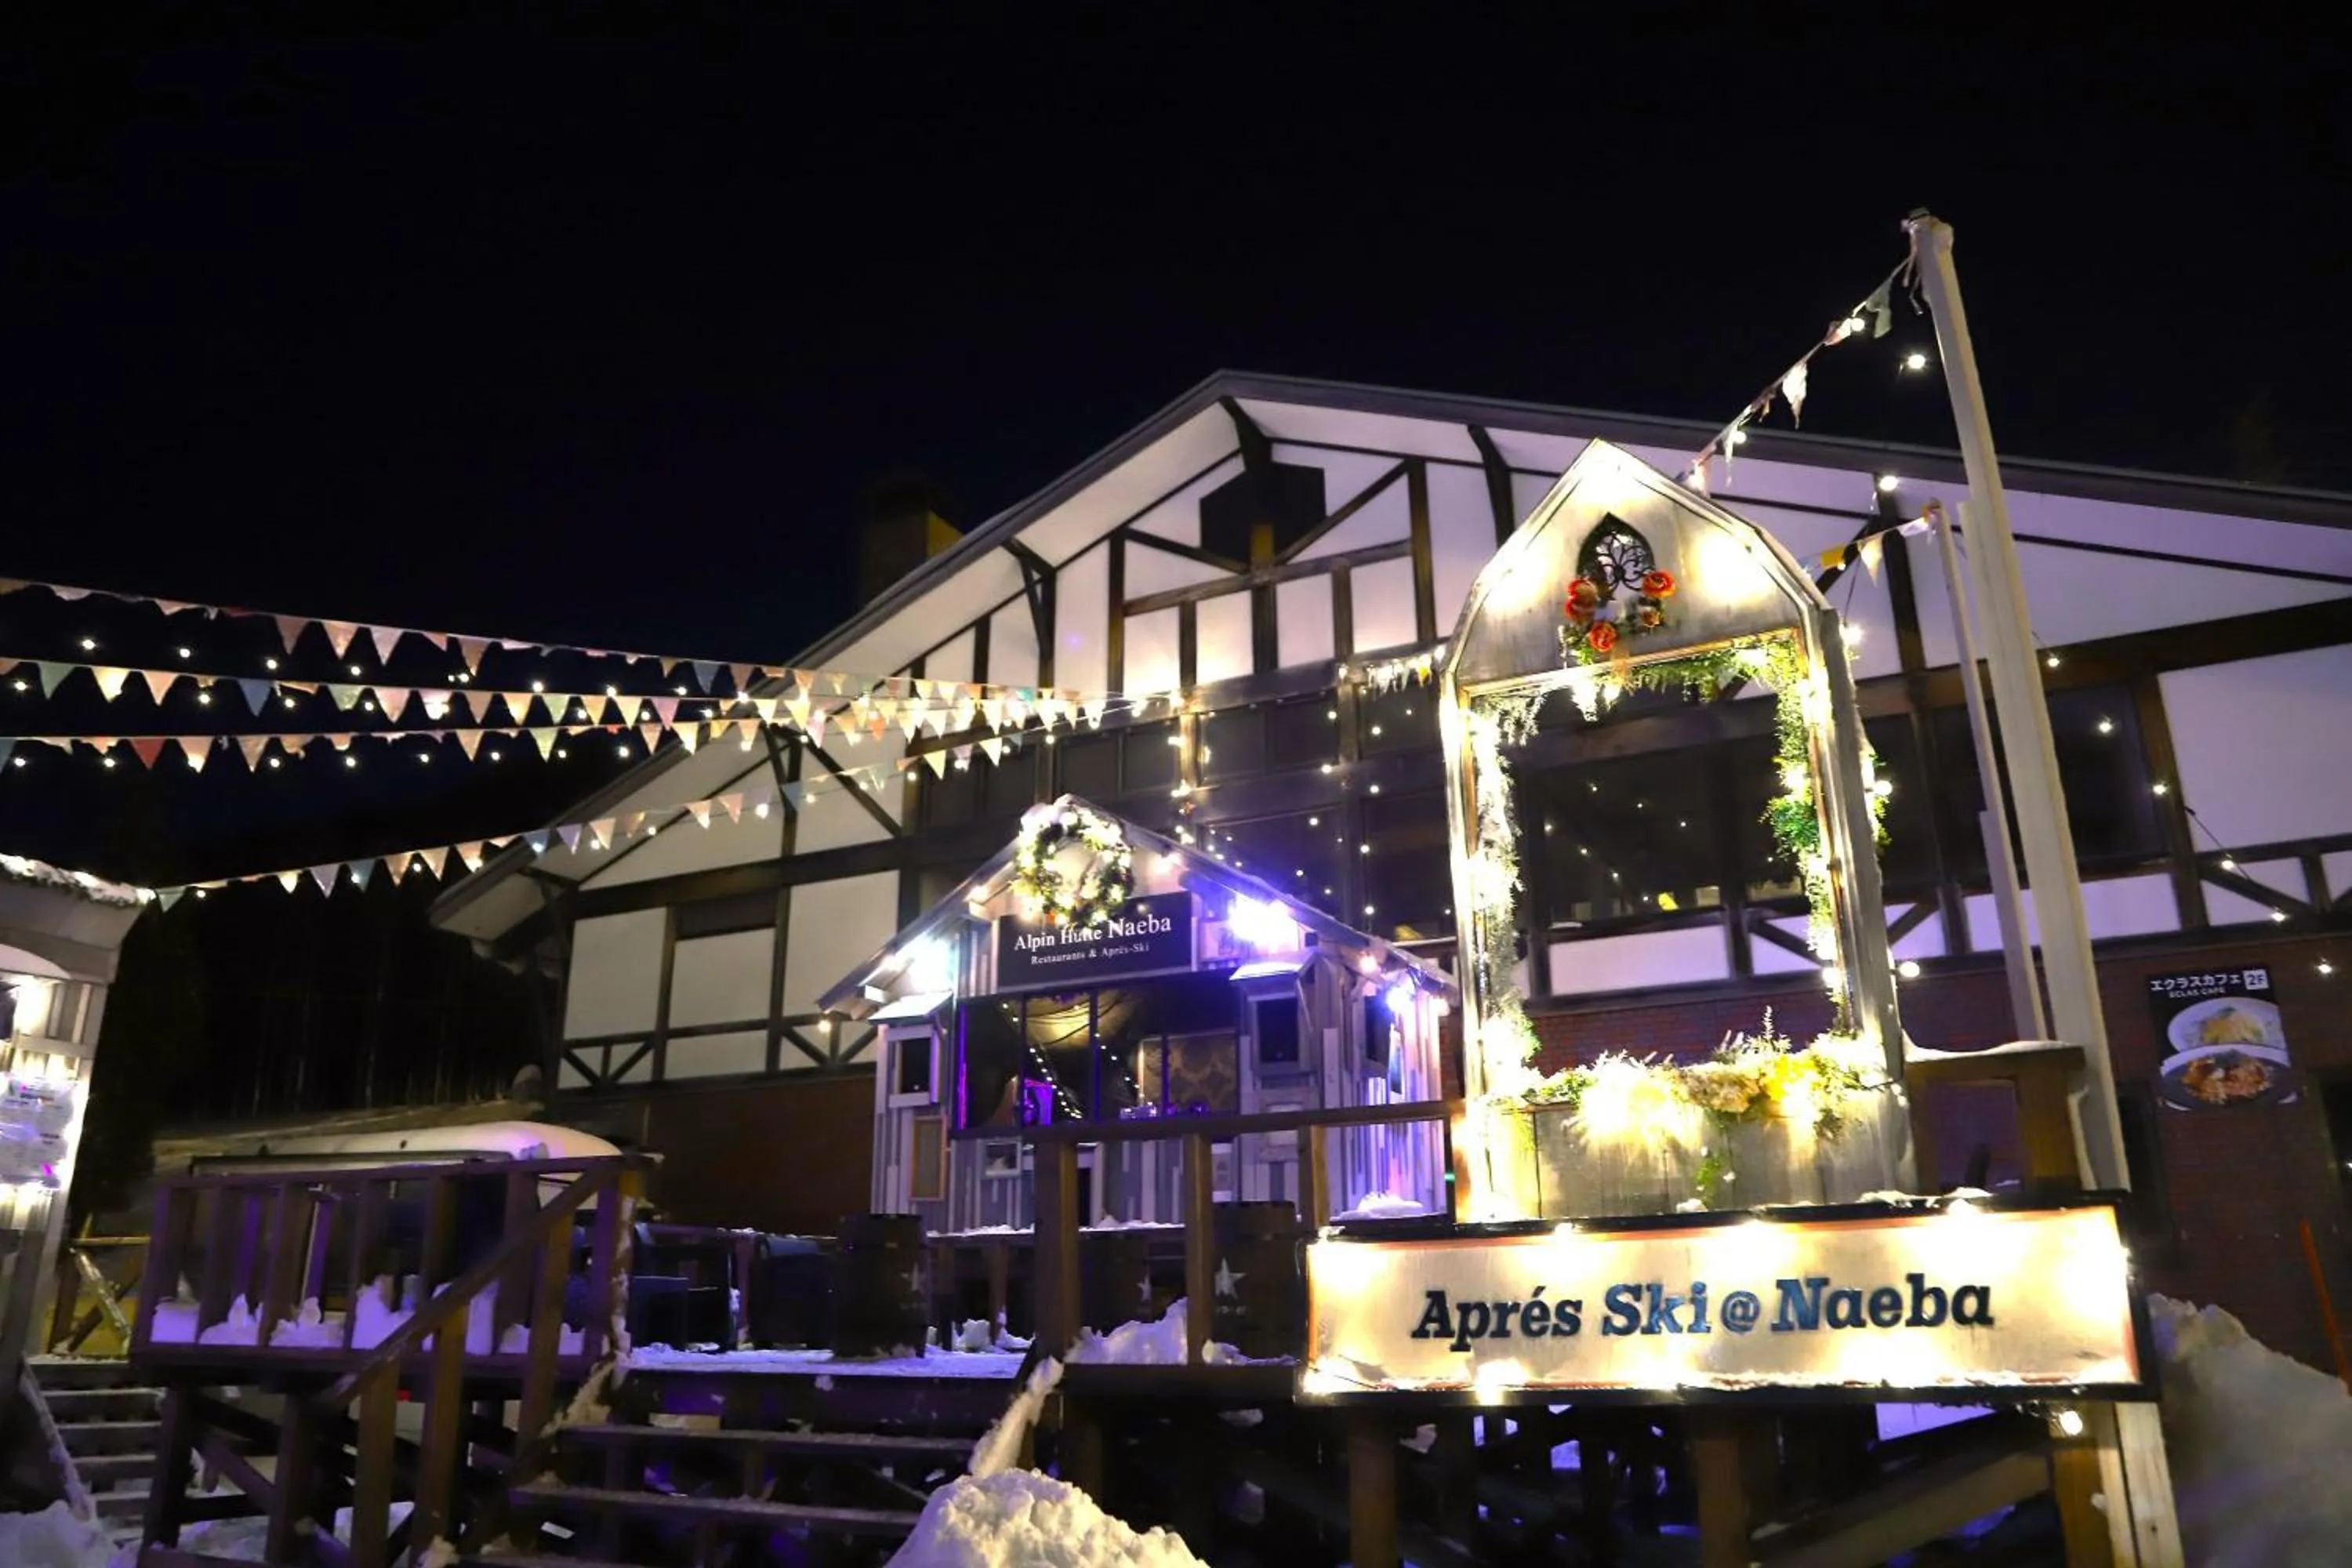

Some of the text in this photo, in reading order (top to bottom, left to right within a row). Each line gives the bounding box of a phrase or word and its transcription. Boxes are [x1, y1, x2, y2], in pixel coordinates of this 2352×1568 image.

[1014, 931, 1054, 953] Alpin
[1108, 913, 1172, 938] Naeba
[1088, 948, 1098, 958] &
[2247, 973, 2265, 986] 2F
[1410, 1285, 1582, 1352] Aprés
[1770, 1273, 1994, 1332] Naeba
